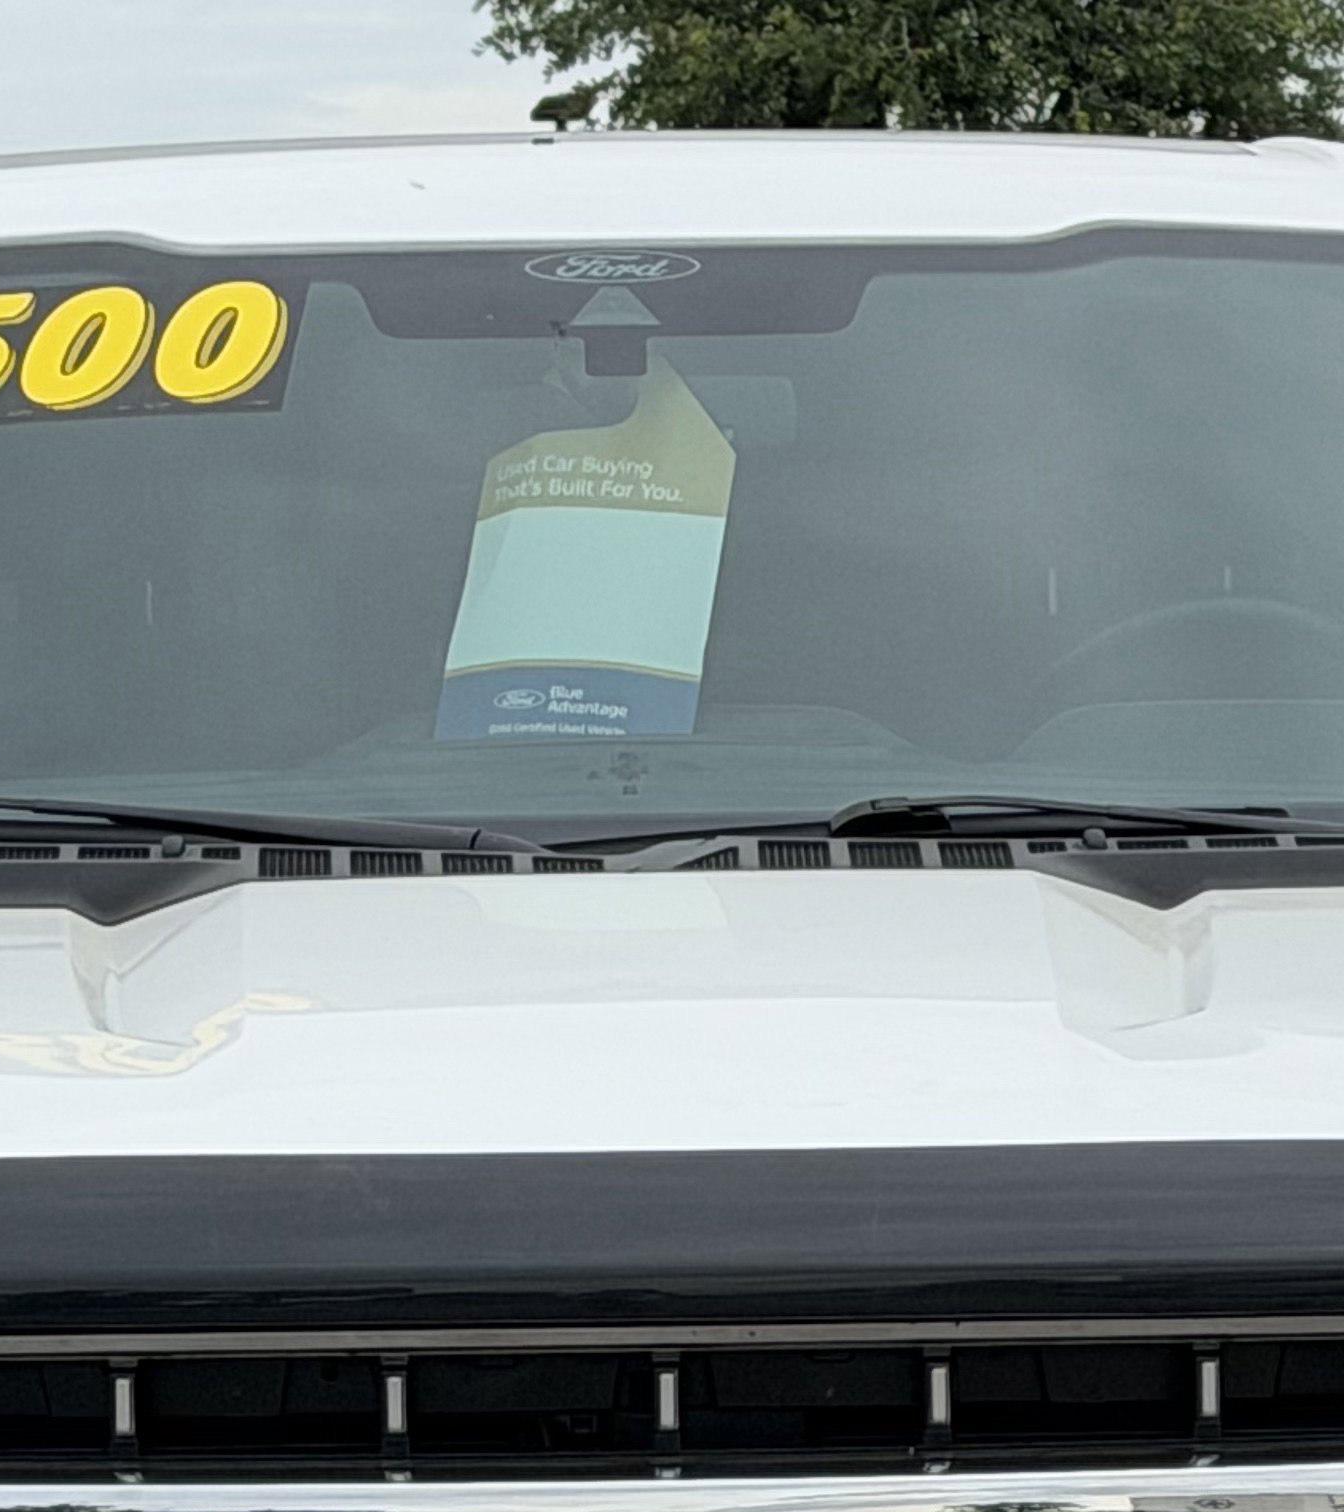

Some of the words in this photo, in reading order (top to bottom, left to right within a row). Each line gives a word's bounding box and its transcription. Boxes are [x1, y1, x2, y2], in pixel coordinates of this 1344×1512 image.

[556, 254, 670, 278] Ford
[543, 454, 576, 473] Car
[582, 455, 654, 481] Buying
[548, 478, 594, 498] Built
[600, 480, 635, 499] For
[640, 482, 684, 502] You.
[550, 685, 584, 700] Blue
[548, 700, 629, 719] Advantage
